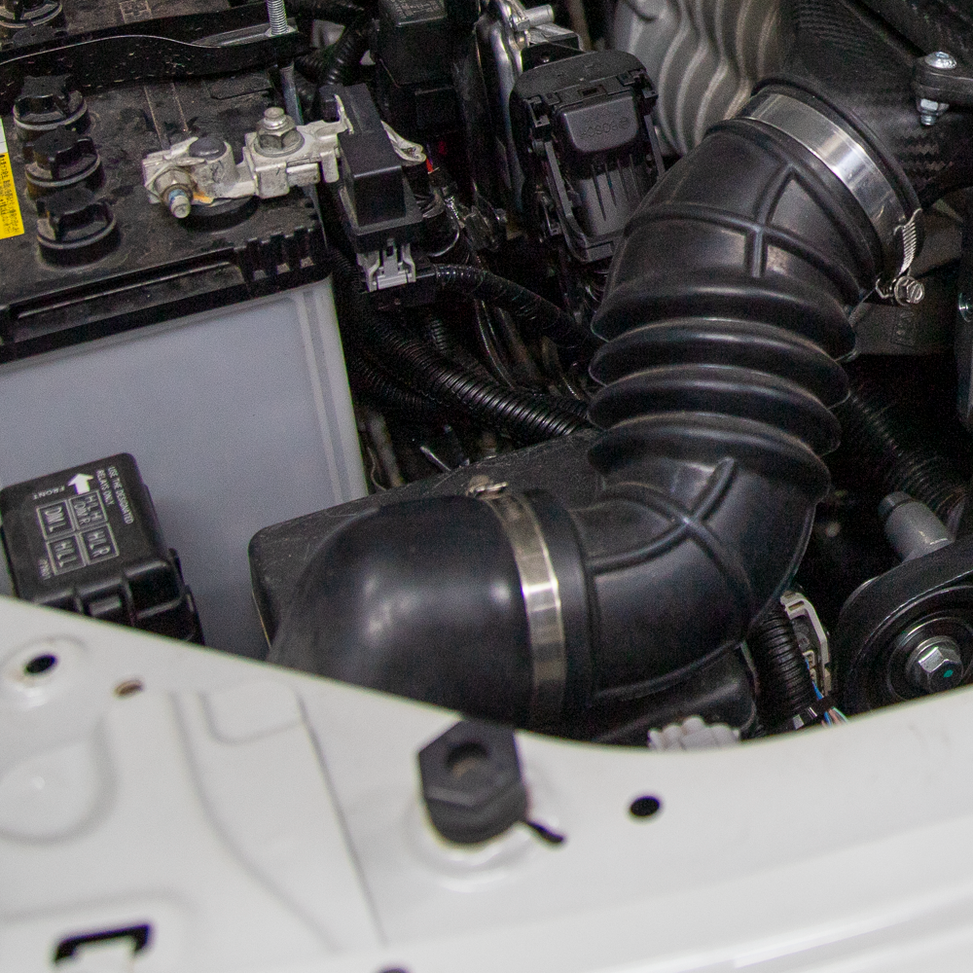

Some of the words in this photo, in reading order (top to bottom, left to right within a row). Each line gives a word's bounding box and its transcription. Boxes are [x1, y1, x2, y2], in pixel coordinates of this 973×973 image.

[108, 465, 119, 478] USE
[96, 469, 110, 491] RELAYS
[112, 477, 123, 490] THE
[32, 485, 65, 501] FRONT
[115, 489, 135, 525] DESIGNATED
